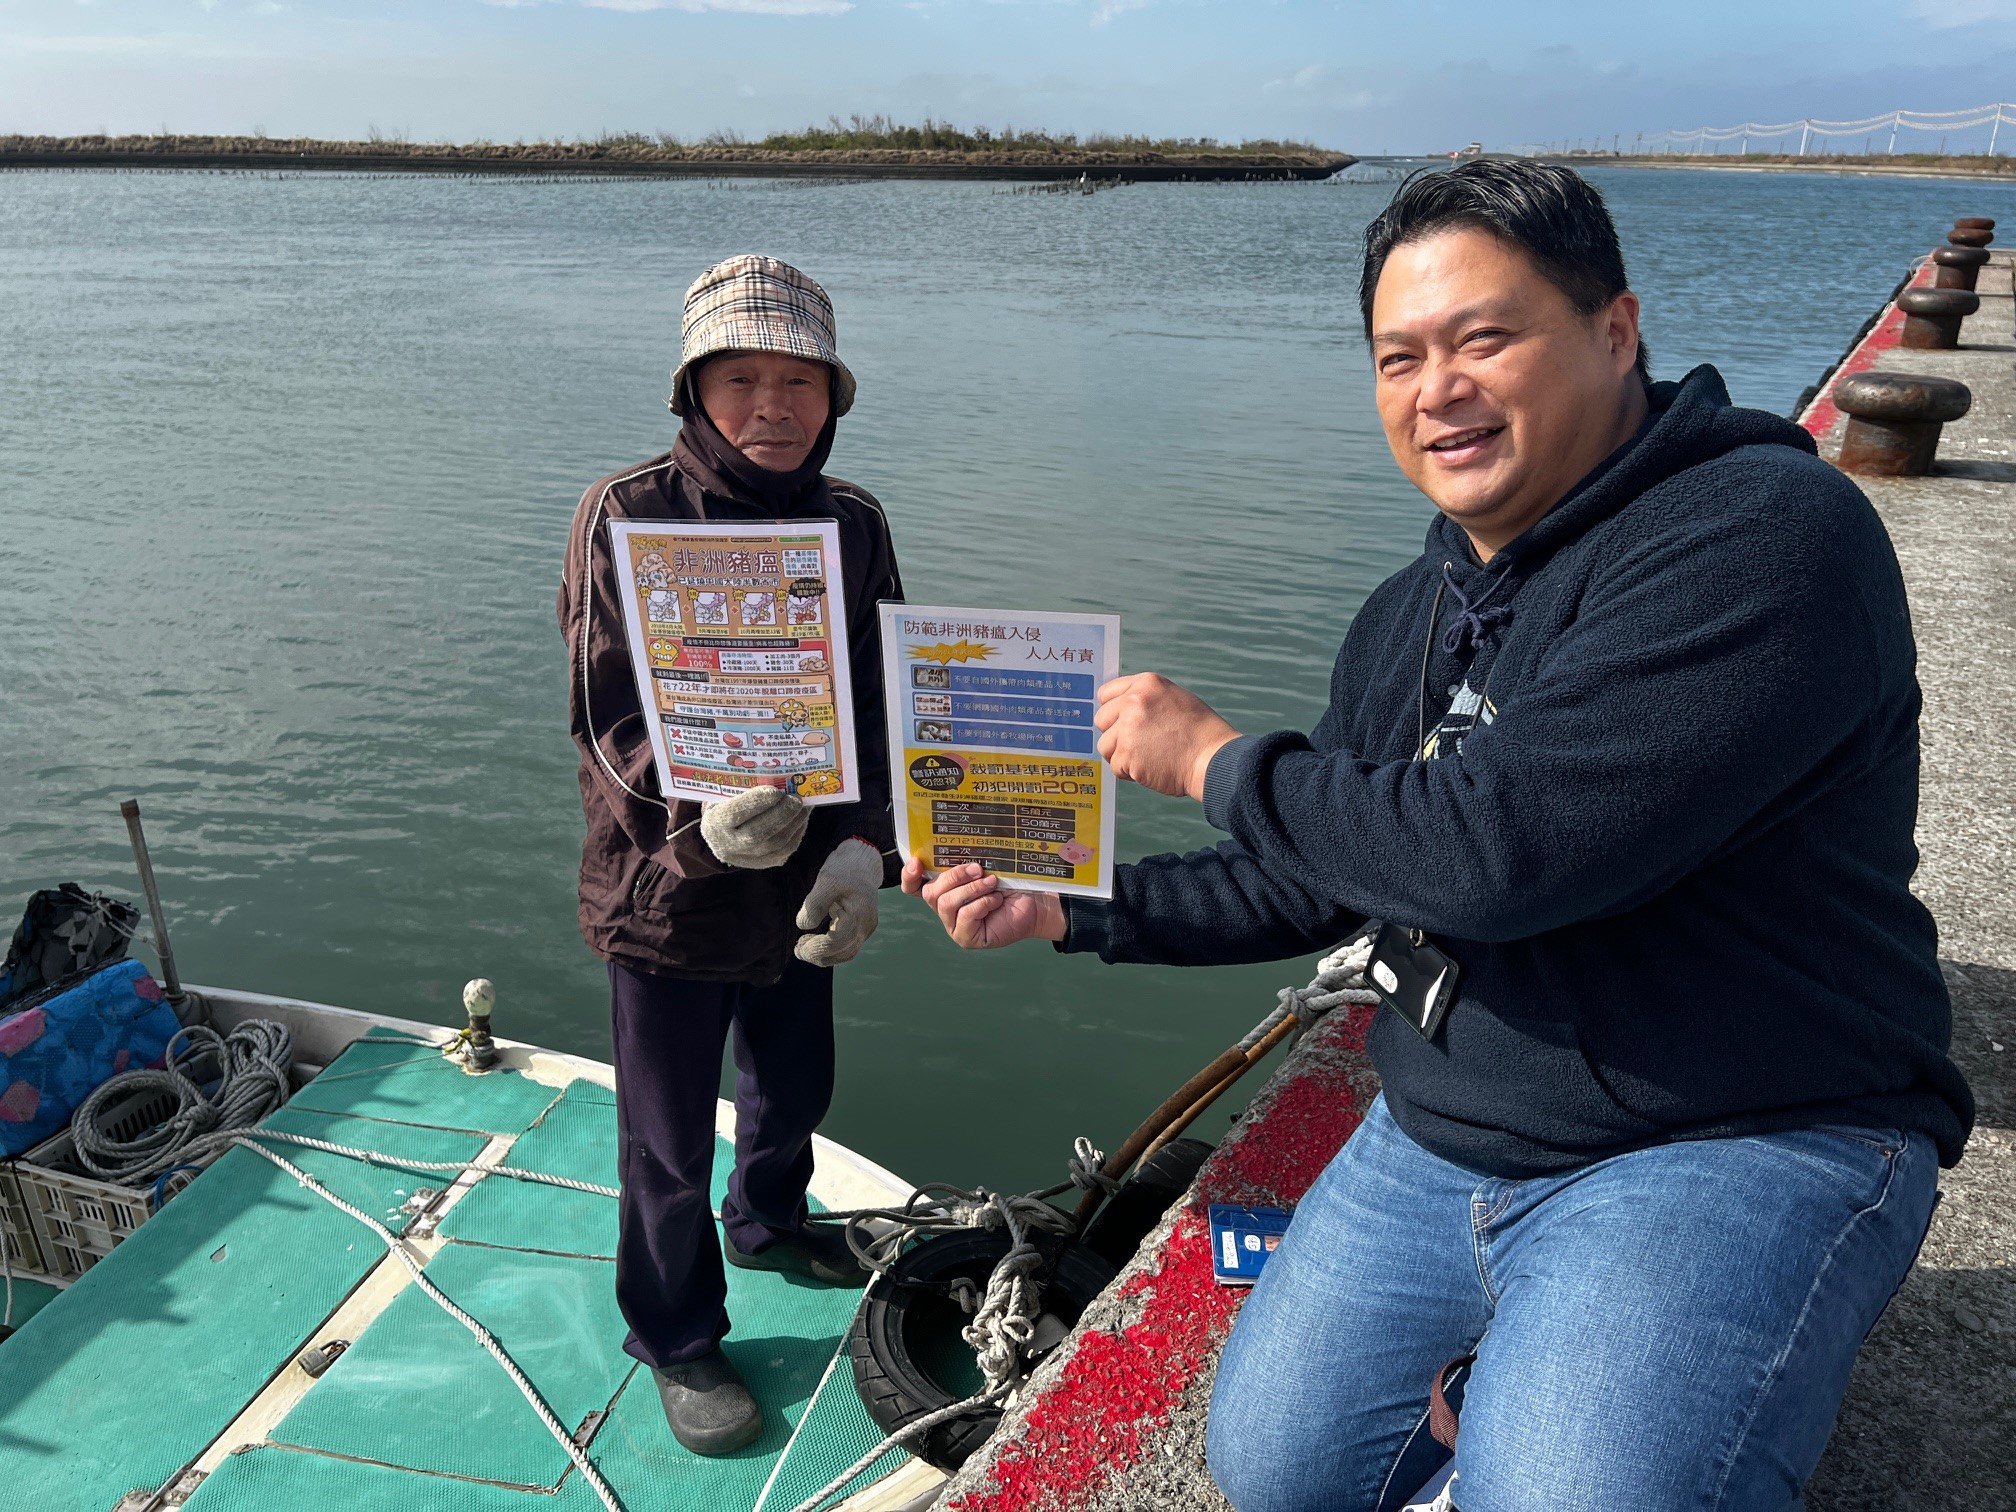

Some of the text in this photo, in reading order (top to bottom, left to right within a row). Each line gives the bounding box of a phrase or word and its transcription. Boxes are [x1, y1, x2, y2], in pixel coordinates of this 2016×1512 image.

[674, 548, 780, 574] 非洲豬瘟
[904, 620, 1041, 642] 防範非洲豬瘟入侵
[1025, 646, 1094, 663] 人人有責
[954, 675, 1072, 690] 不要自國外攜帶肉類產品入境
[663, 682, 818, 695] 花了22年才即將在2020年脫離口蹄疫疫區
[969, 763, 1094, 778] 裁罰基準再提高
[920, 778, 957, 786] 勿忽視
[972, 780, 1097, 796] 初犯開罰20萬
[936, 802, 969, 811] 第一次
[1021, 807, 1052, 816] 5萬元
[936, 814, 969, 823] 第二次
[1021, 818, 1061, 829] 50萬元
[937, 825, 992, 836] 第三次以上
[1021, 830, 1068, 841] 100萬元
[938, 846, 971, 855] 第一次
[1021, 852, 1060, 863] 20萬元
[1021, 864, 1067, 876] 100萬元
